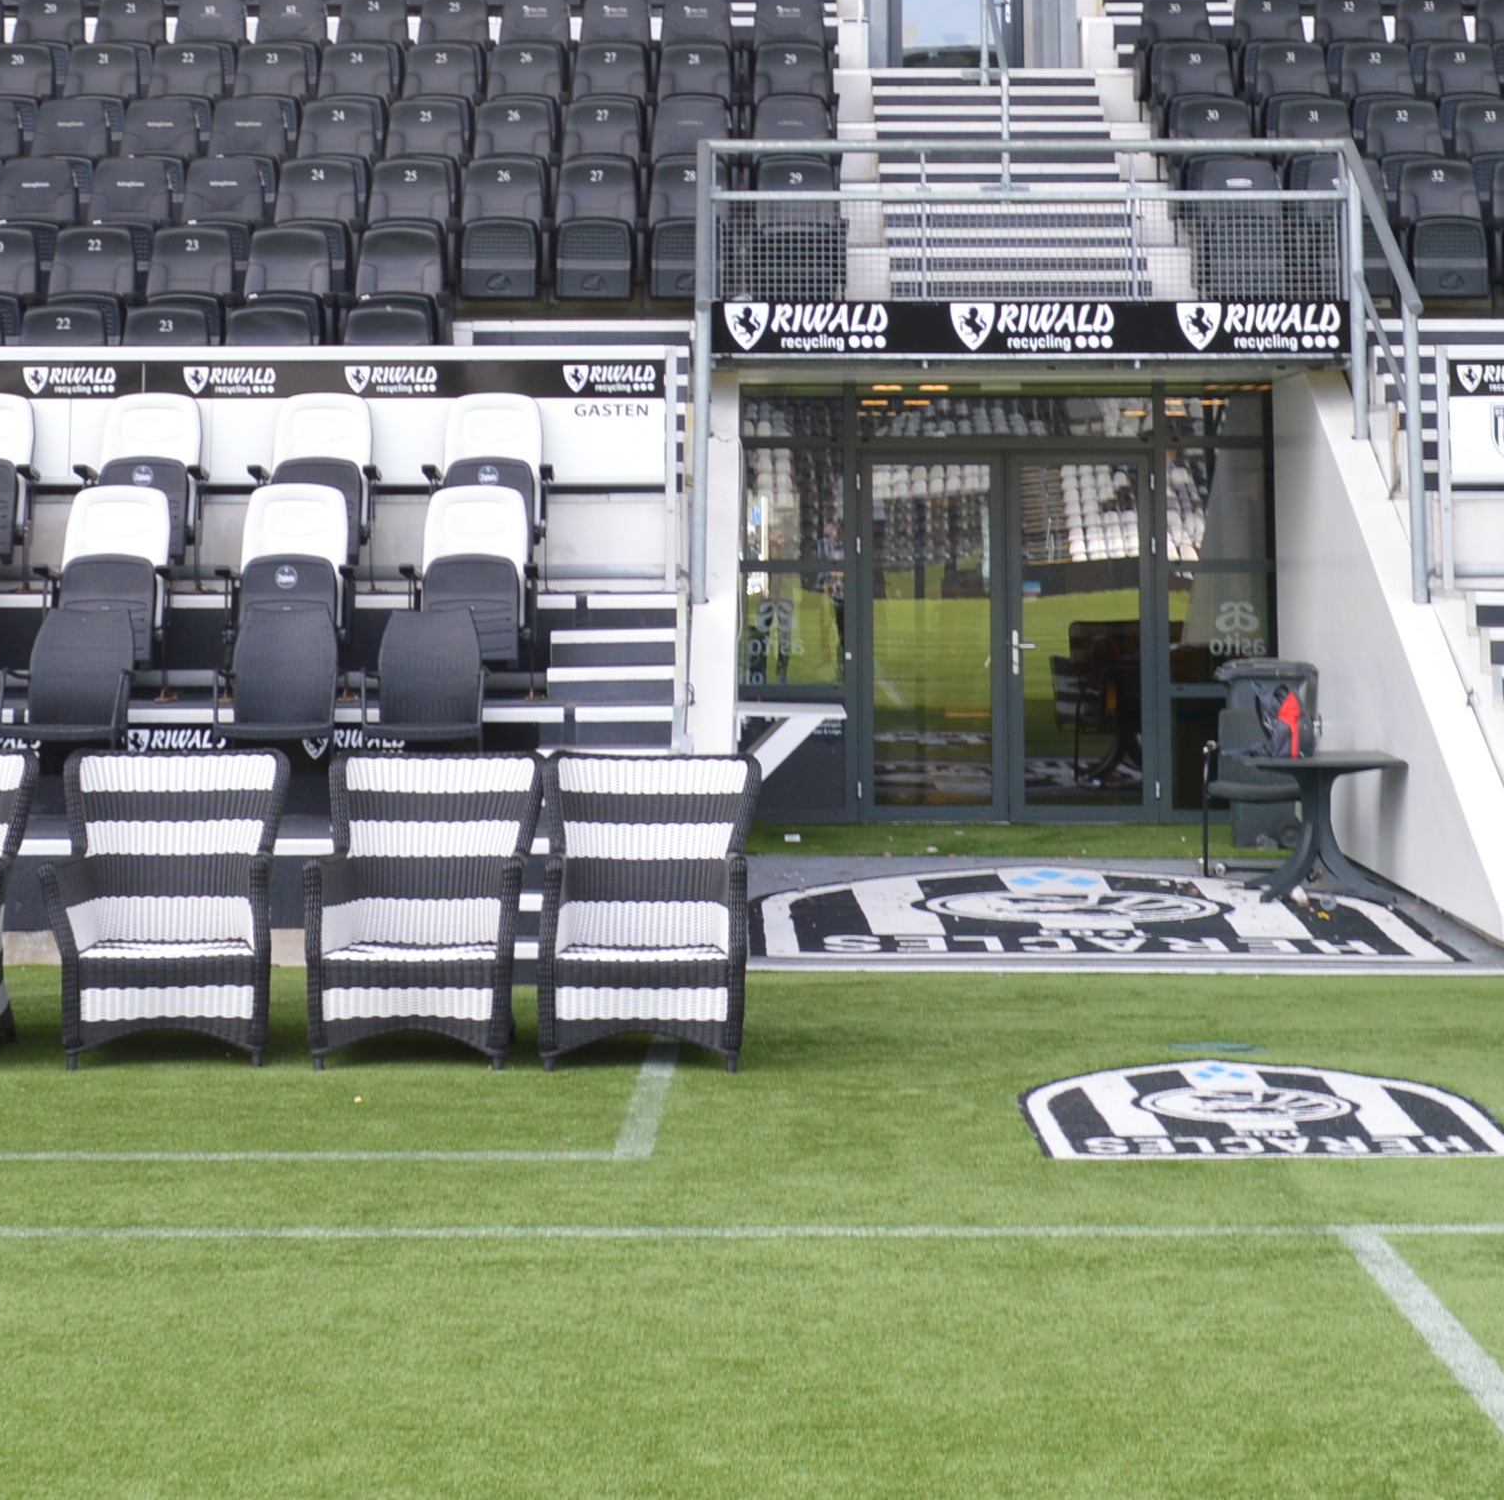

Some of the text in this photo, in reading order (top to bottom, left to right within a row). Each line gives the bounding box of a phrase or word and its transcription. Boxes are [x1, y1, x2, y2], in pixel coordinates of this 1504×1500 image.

[125, 2, 136, 14] 21
[11, 54, 25, 66] 20
[784, 53, 798, 65] 29
[332, 109, 345, 122] 24
[311, 168, 325, 181] 24
[497, 169, 511, 183] 26
[590, 169, 604, 182] 27
[789, 171, 803, 185] 29
[87, 238, 102, 252] 22
[185, 238, 200, 252] 23
[56, 317, 71, 330] 22
[771, 303, 888, 333] RIWALD
[998, 303, 1115, 333] RIWALD
[1224, 303, 1341, 333] RIWALD
[158, 319, 174, 333] 23
[780, 335, 844, 352] recycling
[1007, 335, 1071, 352] recycling
[1233, 335, 1297, 352] recycling
[49, 366, 115, 385] RIWALD
[209, 366, 275, 385] RIWALD
[371, 365, 437, 384] RIWALD
[589, 364, 655, 383] RIWALD
[54, 384, 91, 395] recycling
[214, 384, 251, 395] recycling
[376, 383, 413, 394] recycling
[594, 382, 631, 393] recycling
[574, 403, 649, 418] GASTEN
